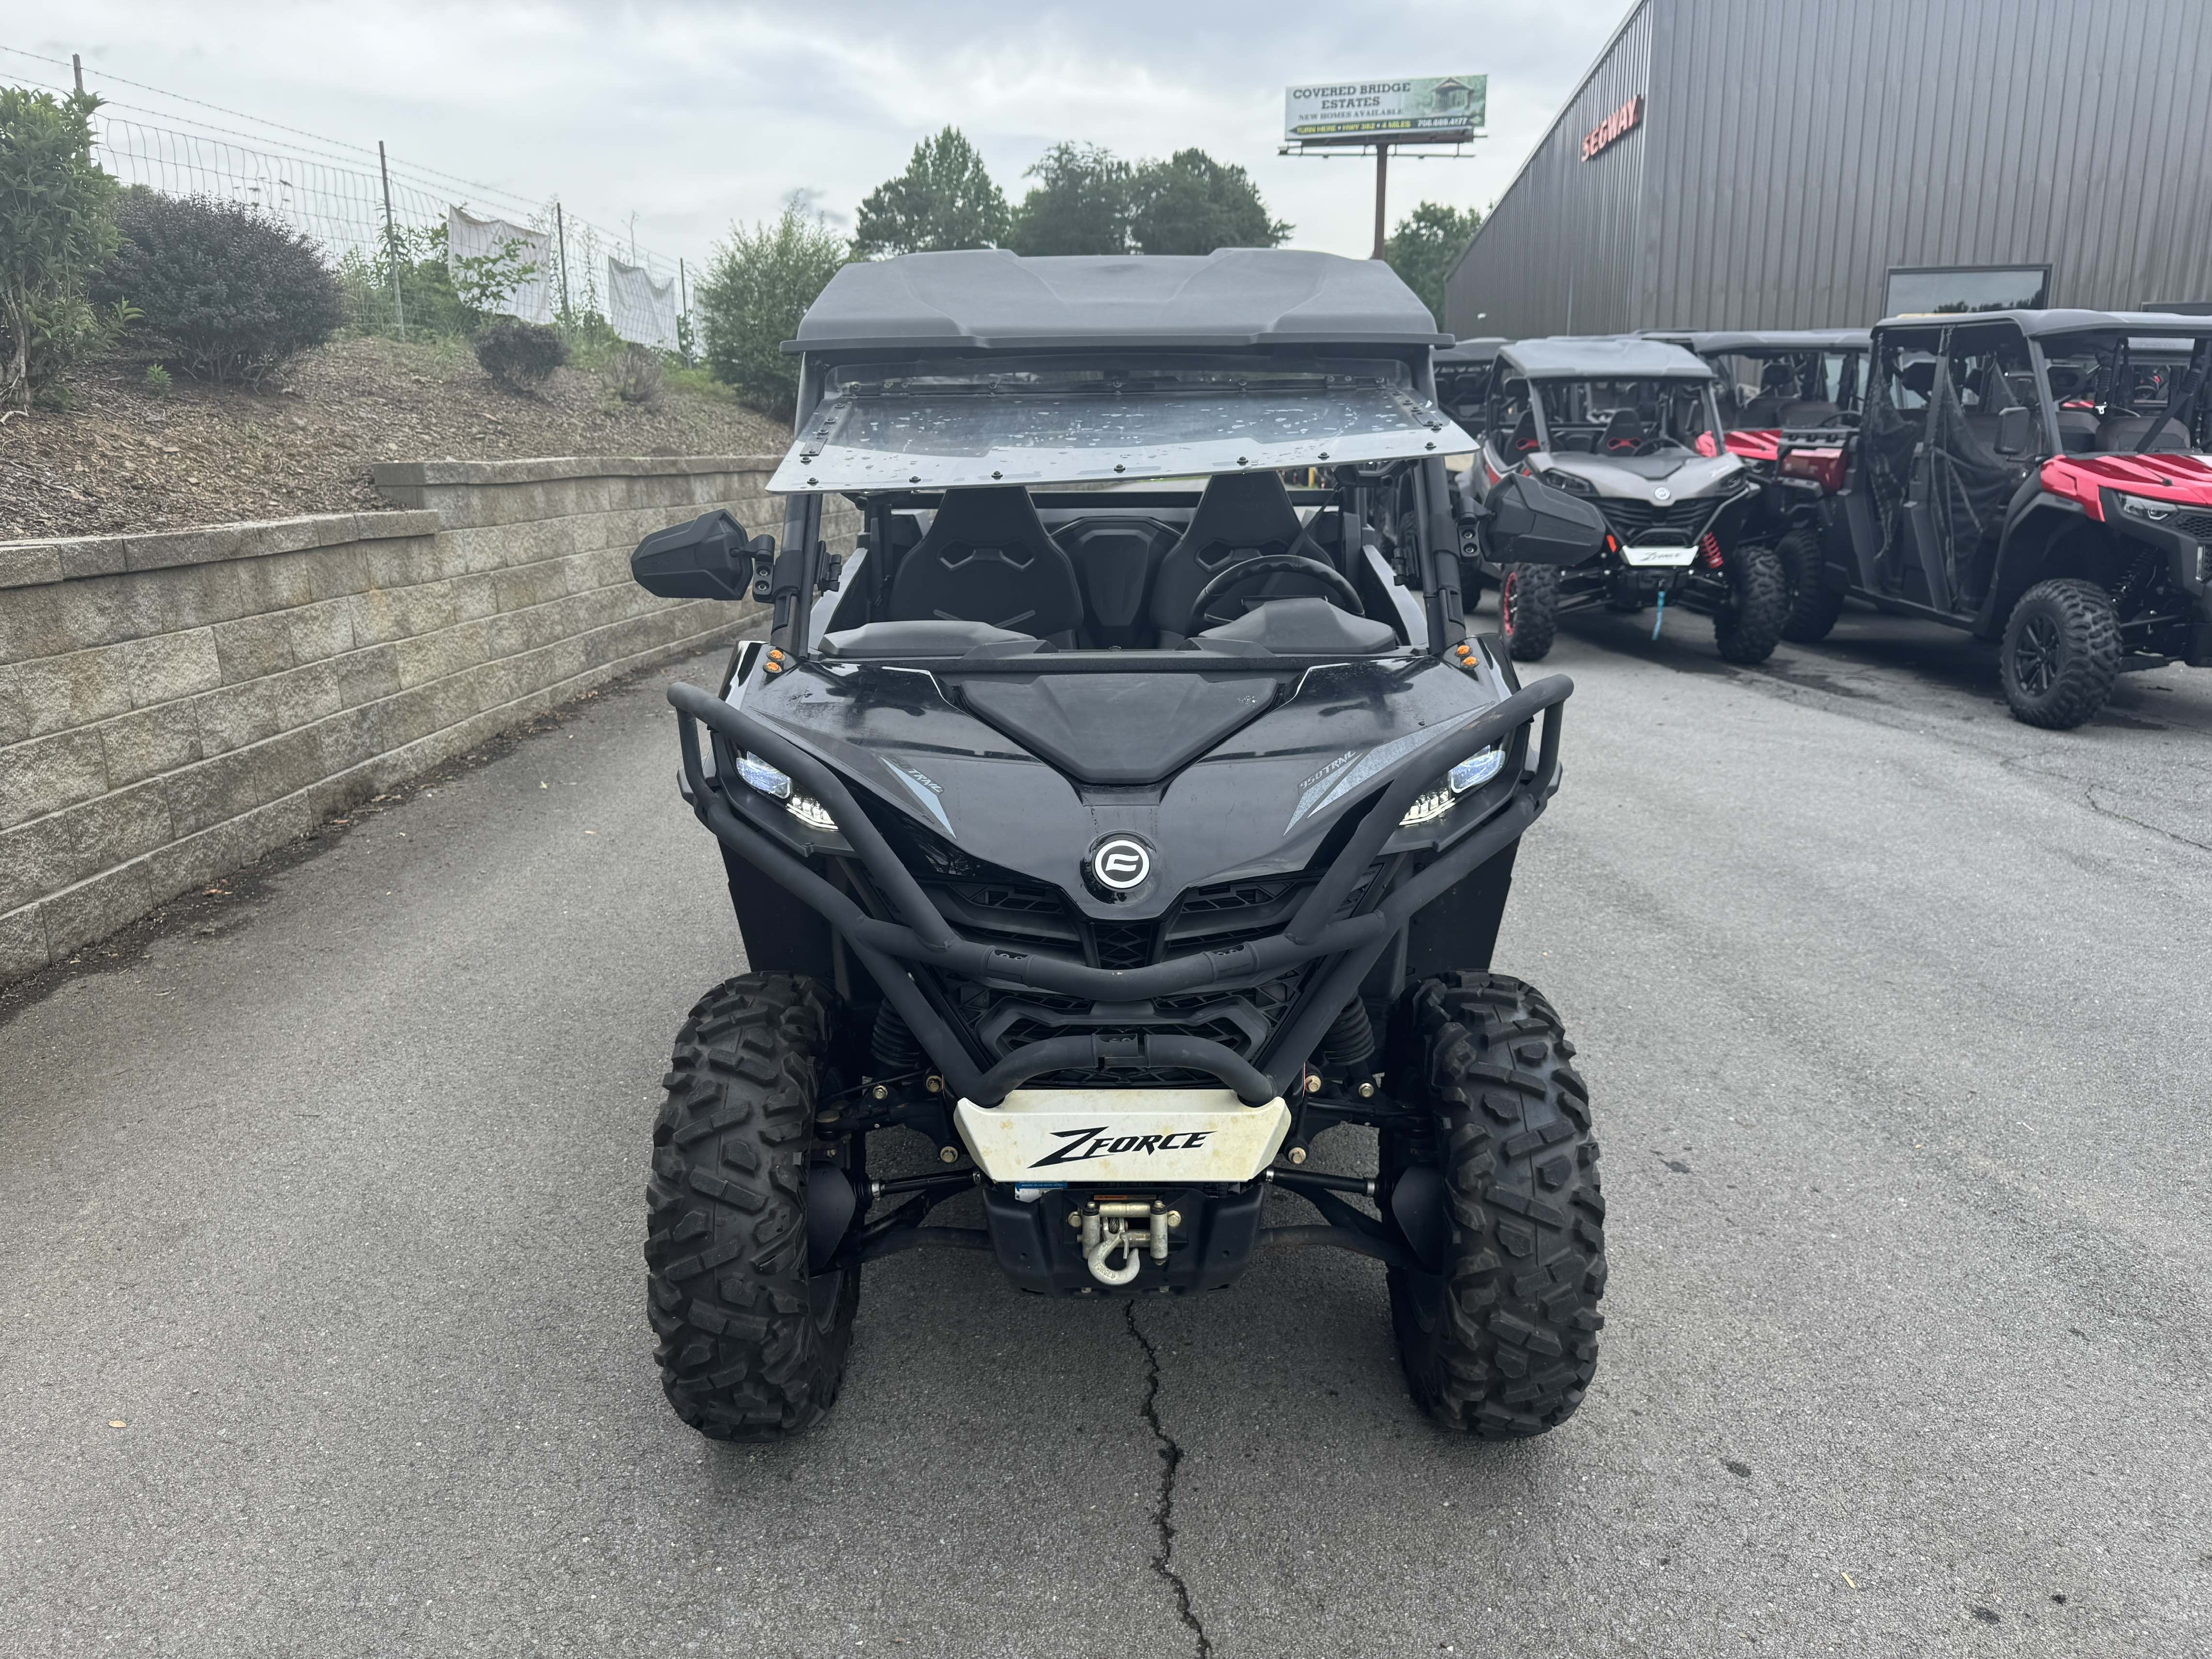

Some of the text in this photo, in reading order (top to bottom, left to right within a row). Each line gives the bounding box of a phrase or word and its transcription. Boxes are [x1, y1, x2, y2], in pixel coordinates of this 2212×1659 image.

[1293, 82, 1411, 99] COVERED BRIDGE
[1322, 96, 1380, 109] ESTATES
[1320, 111, 1352, 120] HOMES
[1353, 108, 1403, 118] AVAILABLE
[1388, 120, 1411, 128] MILES
[1581, 94, 1639, 162] SEGWAY
